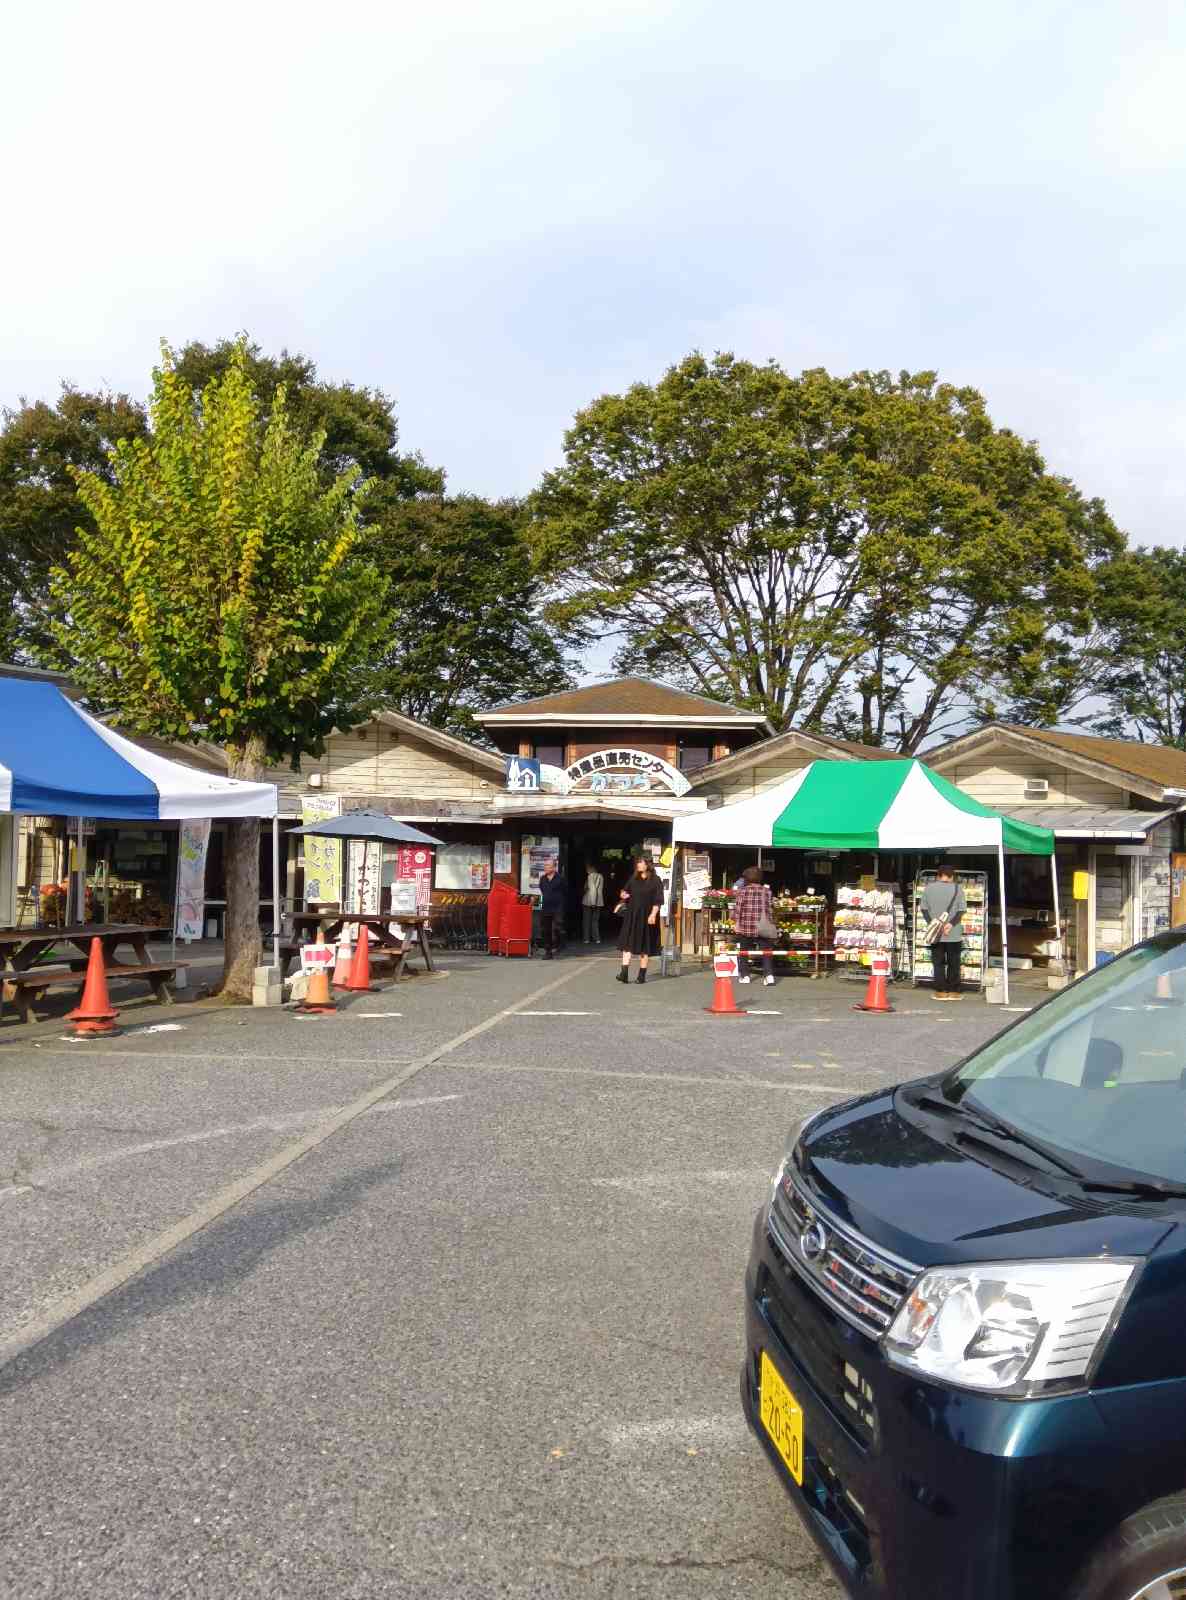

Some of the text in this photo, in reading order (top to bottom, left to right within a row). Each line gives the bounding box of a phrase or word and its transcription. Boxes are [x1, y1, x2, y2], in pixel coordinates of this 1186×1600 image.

[568, 751, 673, 782] 特産品直売センター
